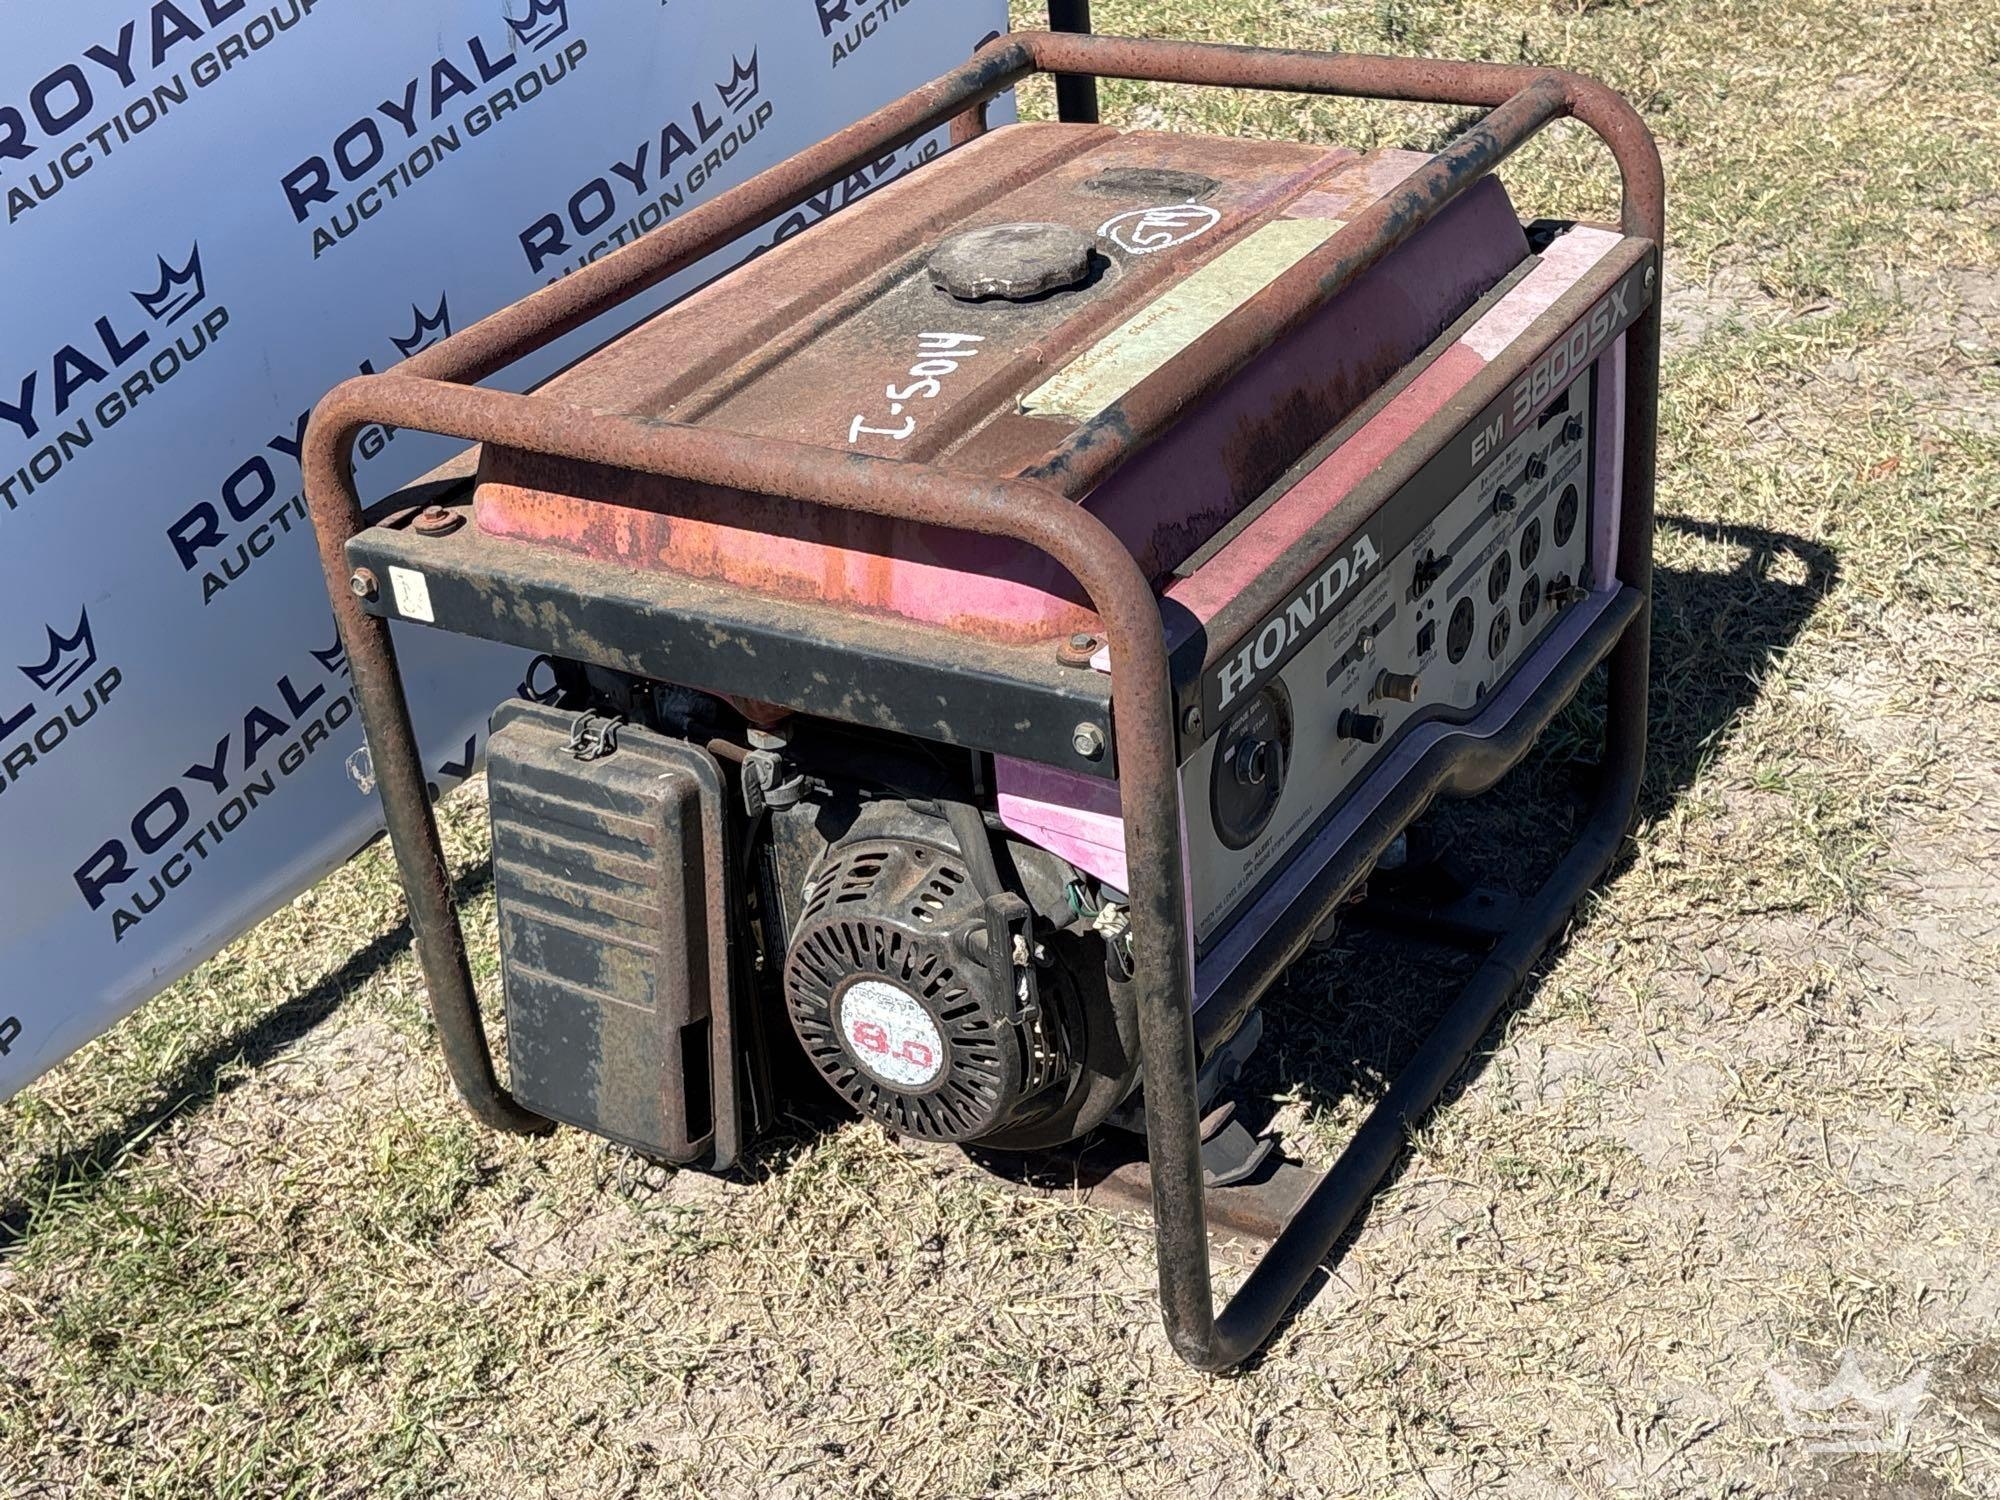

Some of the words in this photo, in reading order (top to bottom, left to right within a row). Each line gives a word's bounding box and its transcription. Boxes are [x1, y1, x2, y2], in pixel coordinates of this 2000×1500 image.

[832, 0, 910, 69] AUCTI
[8, 75, 189, 224] AUCTION
[280, 35, 516, 224] ROYAL
[313, 125, 462, 260] AUCTION
[464, 39, 587, 138] GROUP
[518, 101, 724, 274] ROYAL
[686, 101, 773, 194] GROUP
[0, 315, 150, 439] YAL
[0, 418, 93, 511] TION
[95, 306, 229, 429] GROUP
[1472, 414, 1504, 467] EM
[1513, 279, 1629, 428] 3800SX
[204, 484, 312, 606] AUCTI
[1217, 534, 1380, 711] HONDA
[73, 675, 326, 911] ROYAL
[113, 769, 277, 943] AUCTION
[278, 686, 359, 776] GRO
[1254, 835, 1273, 859] ALERT
[853, 1020, 933, 1068] 8.0
